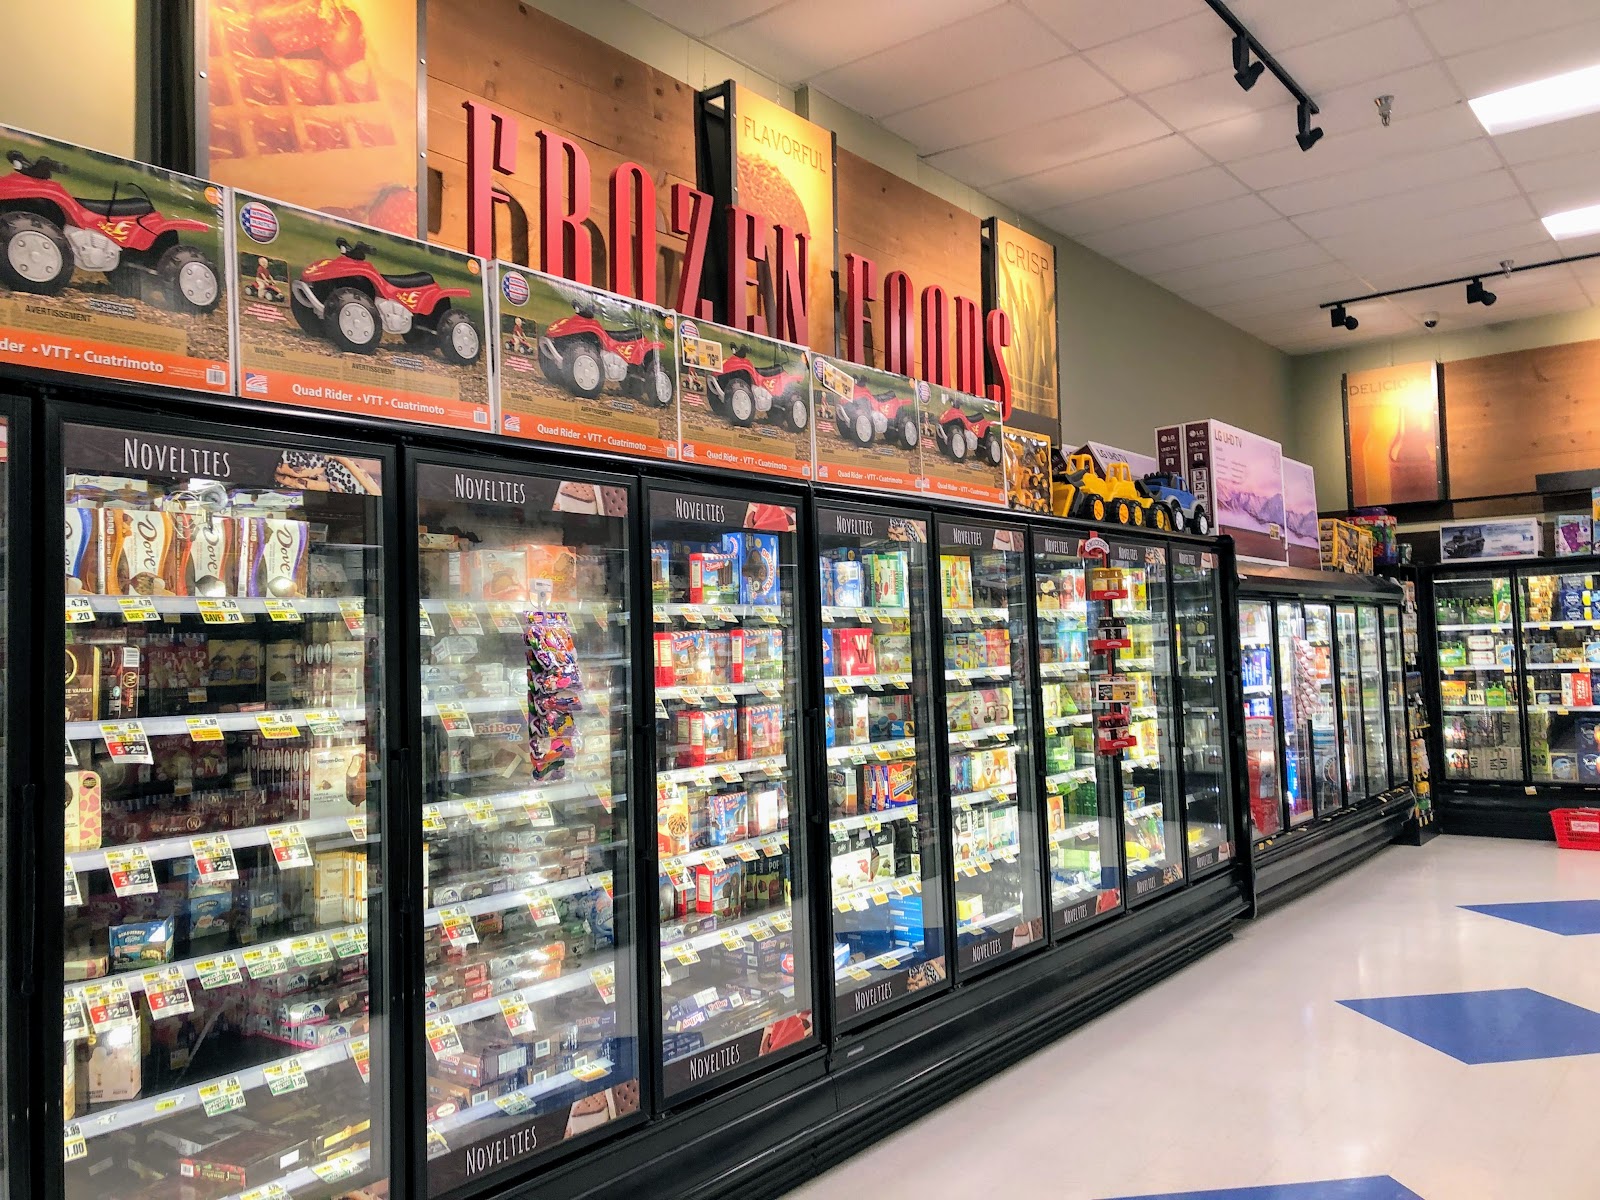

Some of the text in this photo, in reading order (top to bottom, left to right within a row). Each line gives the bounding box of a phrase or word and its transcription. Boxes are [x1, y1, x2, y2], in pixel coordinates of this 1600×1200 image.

[743, 115, 827, 175] FLAVORFUL
[461, 100, 1012, 422] FROZEN FOODS
[1005, 240, 1049, 277] CRISP
[41, 343, 72, 360] VTT
[83, 350, 164, 373] Cuatrimoto
[1350, 376, 1408, 396] DELICIO
[292, 383, 445, 415] Quad Rider VTT Cuatrimoto
[537, 423, 647, 451] Quad Rider VTT Cuatrimoto
[1214, 429, 1243, 449] LG UHD TV
[124, 438, 231, 478] NOVELTIES
[706, 449, 788, 471] Quad Rider VTT Cuatrimoto
[837, 469, 903, 485] Quad Rider VTT Cuatrimoto
[454, 473, 526, 505] NOVELTIES
[675, 498, 725, 523] NOVELTIES
[836, 515, 874, 536] NOVELTIES
[137, 514, 158, 571] Dove
[953, 527, 983, 546] NOVELTIES
[276, 523, 293, 574] Dove
[1044, 538, 1069, 555] NOVELTIES
[761, 547, 775, 596] DRUMSTICK
[71, 598, 89, 607] 4.79
[222, 600, 237, 609] 4.79
[76, 612, 90, 621] .20
[204, 612, 239, 623] SAVE .20
[855, 634, 868, 650] W
[1470, 692, 1482, 702] IPA
[264, 725, 292, 733] Everyday
[474, 722, 521, 735] FatBoy
[508, 733, 523, 742] Jr.
[115, 746, 123, 755] 3
[1500, 757, 1508, 770] IPA
[281, 851, 288, 860] 3
[204, 862, 212, 872] 3
[119, 876, 127, 886] 3
[1063, 903, 1088, 925] NOVELTIES
[451, 929, 458, 938] 3
[972, 938, 1002, 963] NOVELTIES
[156, 998, 165, 1007] 3
[854, 981, 892, 1012] NOVELTIES
[97, 1012, 106, 1021] 3
[511, 1018, 518, 1027] 3
[436, 1041, 443, 1051] 3
[689, 1043, 741, 1082] NOVELTIES
[466, 1125, 537, 1176] NOVELTIES
